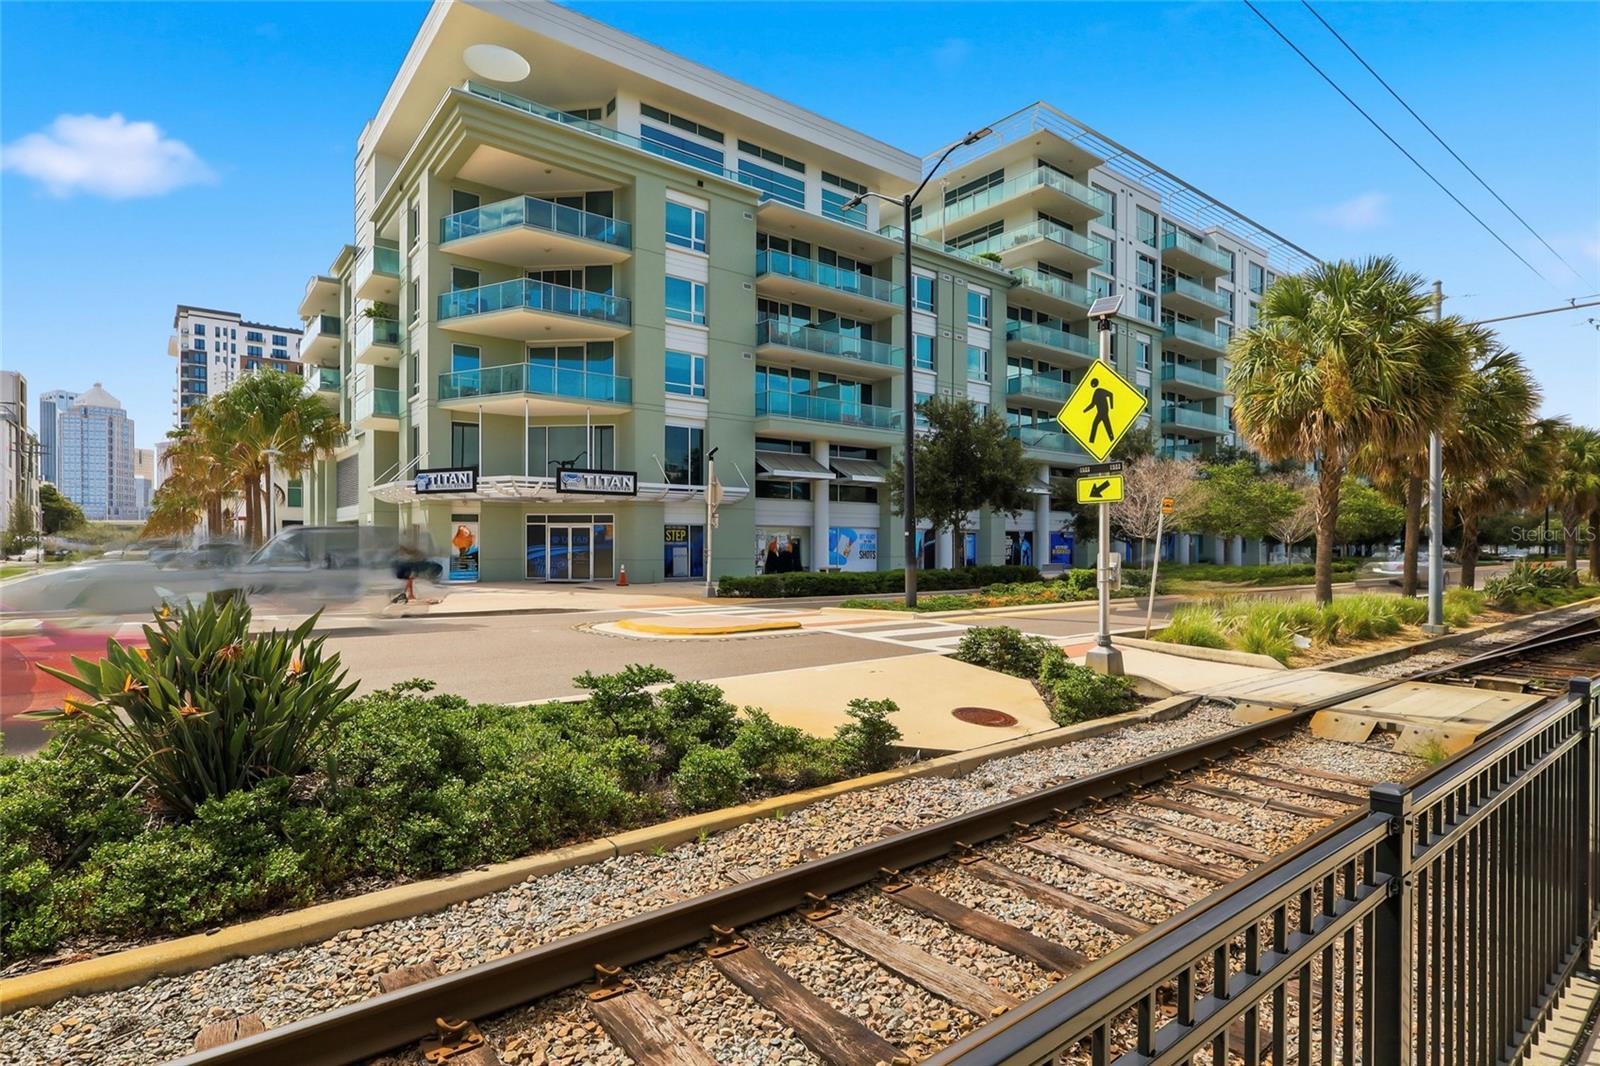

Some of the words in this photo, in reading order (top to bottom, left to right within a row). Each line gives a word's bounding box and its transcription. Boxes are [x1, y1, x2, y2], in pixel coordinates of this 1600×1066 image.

[429, 473, 469, 484] TITAN
[584, 475, 631, 488] TITAN
[665, 529, 686, 541] STEP
[858, 551, 876, 560] SHOTS
